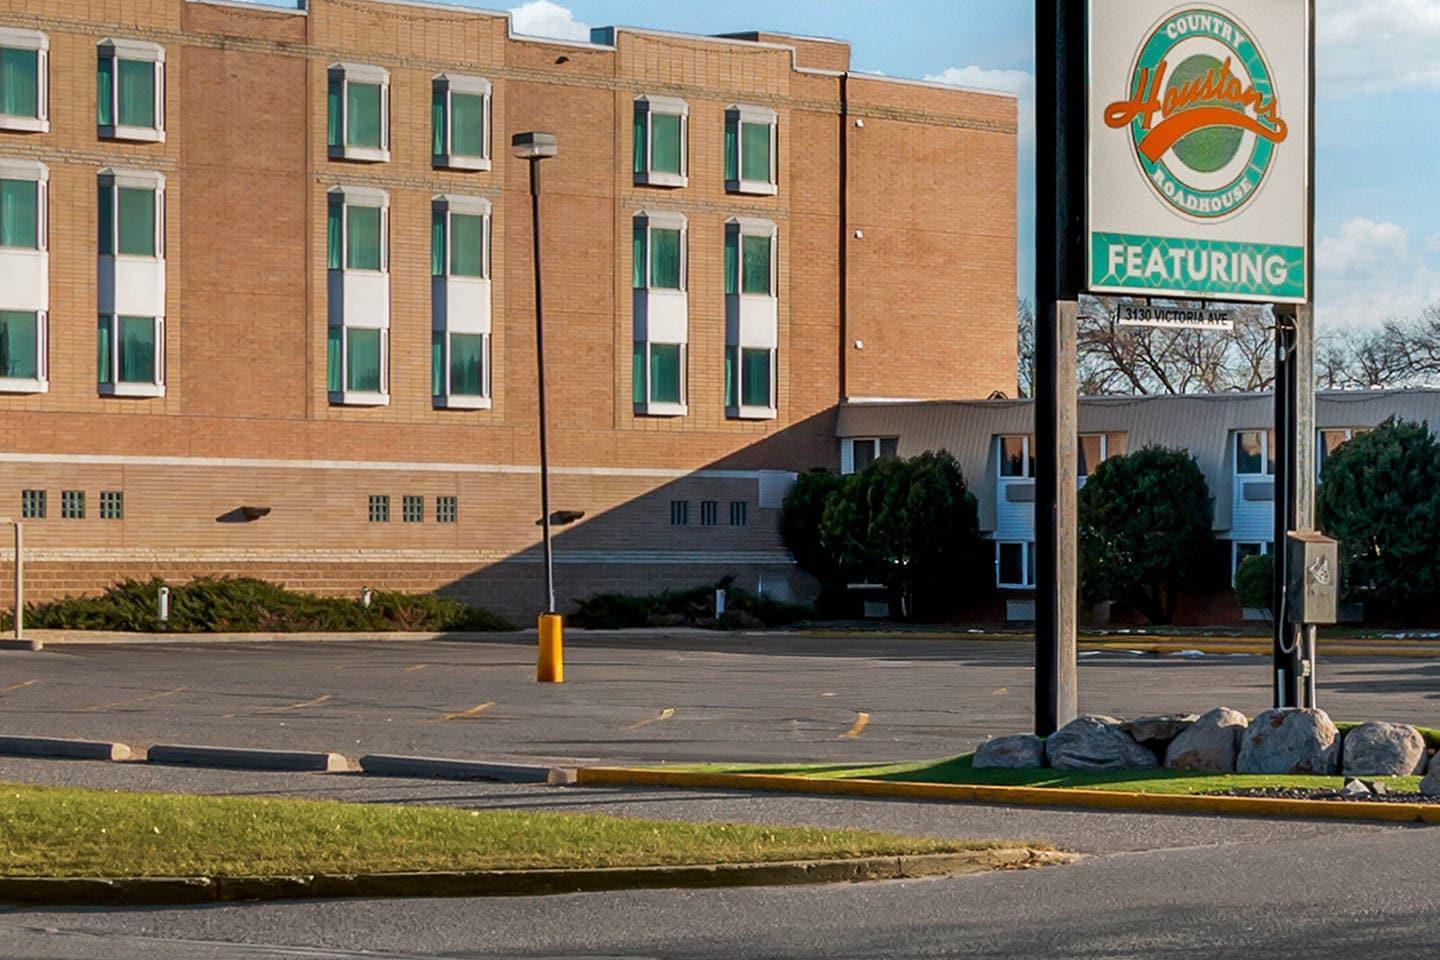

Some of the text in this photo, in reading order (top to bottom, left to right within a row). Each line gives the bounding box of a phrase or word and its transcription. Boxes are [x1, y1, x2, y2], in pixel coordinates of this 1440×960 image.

[1166, 14, 1244, 48] COUNTRY
[1153, 169, 1252, 212] ROADHOUSE
[1108, 243, 1288, 286] FEATURING
[1125, 307, 1228, 326] 3130 VICTORIA AVE
